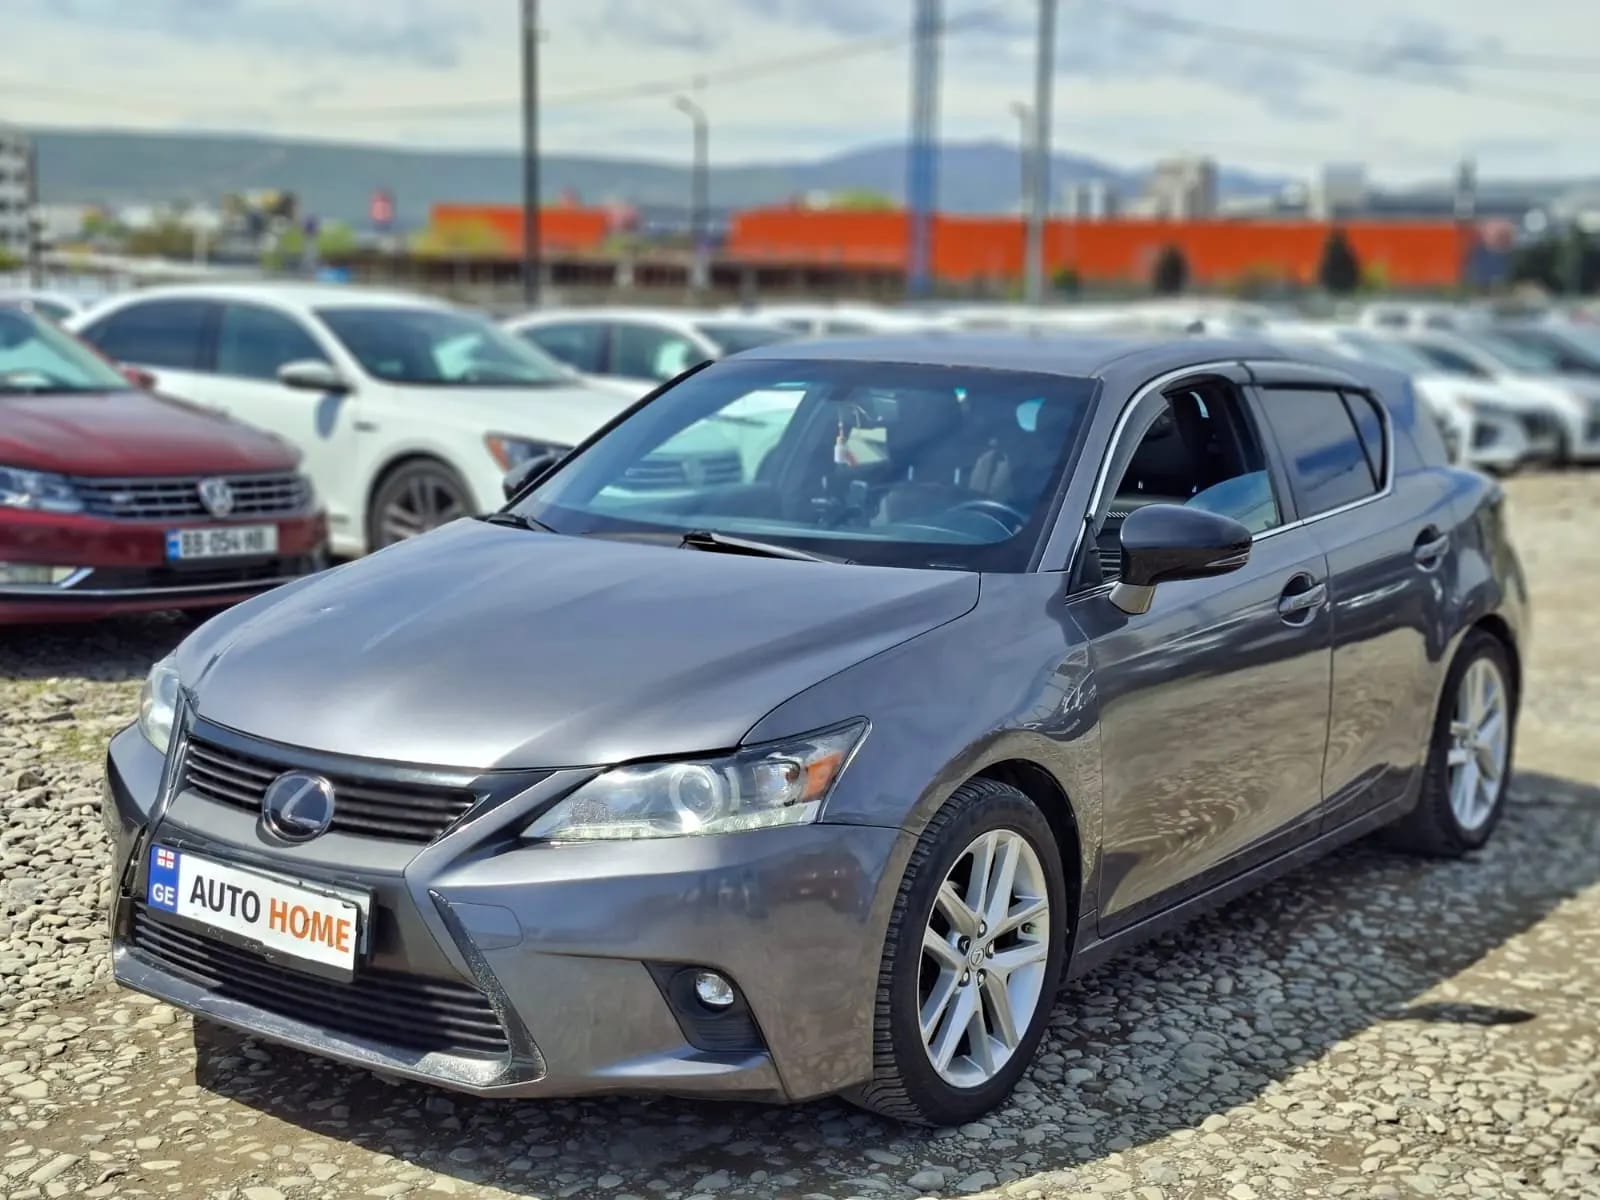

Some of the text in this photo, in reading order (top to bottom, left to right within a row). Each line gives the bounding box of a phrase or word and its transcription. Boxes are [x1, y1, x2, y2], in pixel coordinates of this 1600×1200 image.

[152, 883, 176, 906] GE
[189, 874, 351, 954] AUTO HOME
